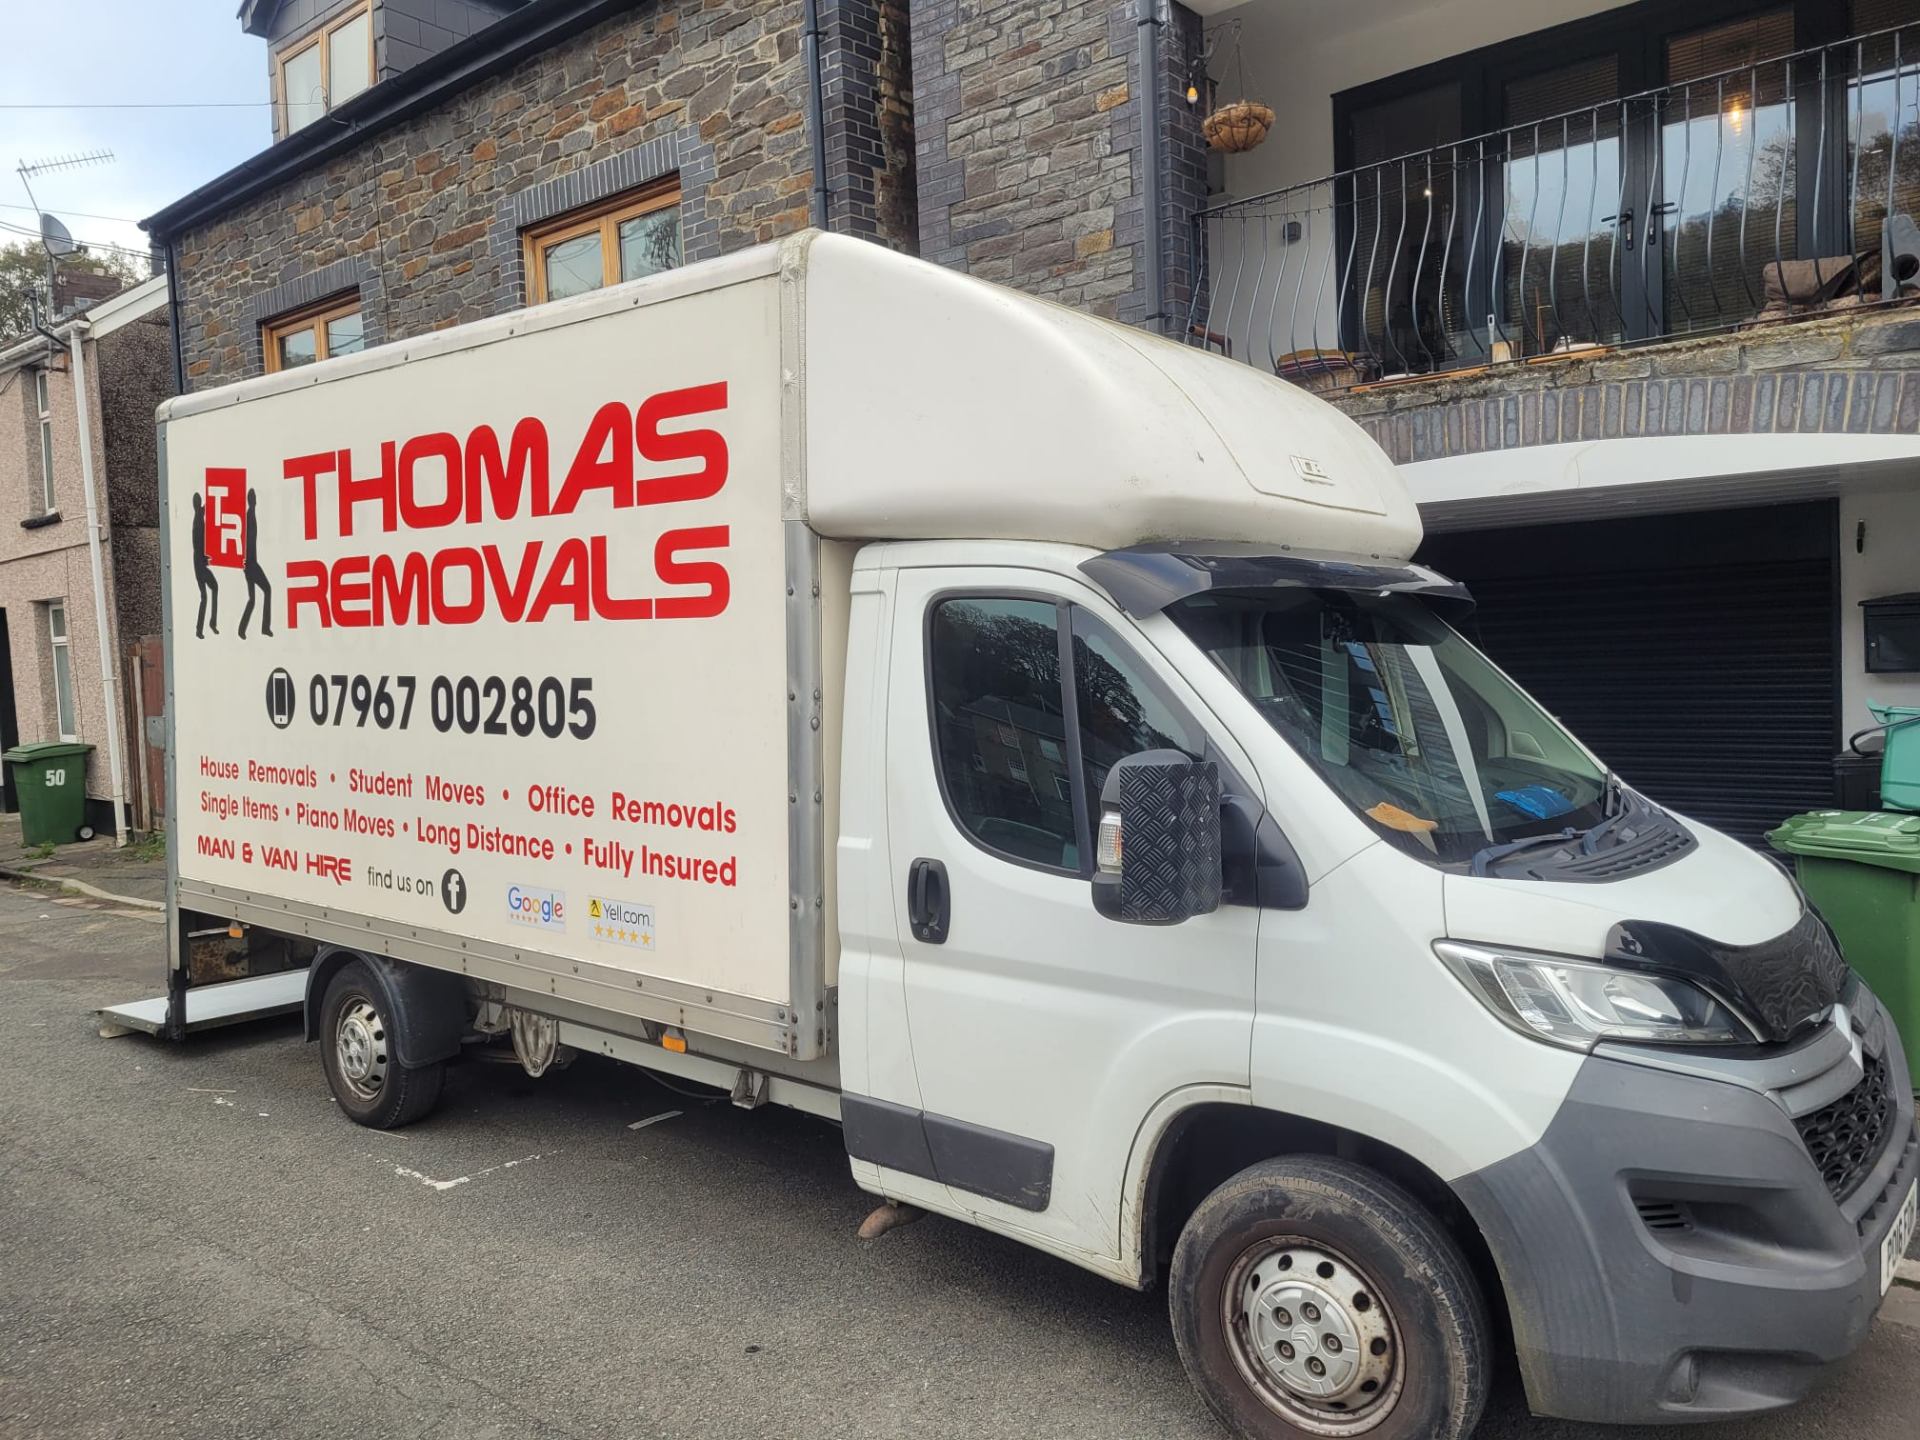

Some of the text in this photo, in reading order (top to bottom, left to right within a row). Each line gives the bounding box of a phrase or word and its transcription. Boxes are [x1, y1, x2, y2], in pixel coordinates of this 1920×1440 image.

[283, 381, 730, 541] THOMAS
[286, 525, 731, 629] REMOVALS
[309, 674, 596, 740] 07967 002805
[45, 769, 65, 787] 50
[200, 755, 737, 833] House Removals Student Moves Office Removals
[198, 835, 235, 860] MAN
[242, 843, 253, 863] &
[261, 845, 298, 872] VAN
[306, 853, 352, 886] HIRE
[367, 866, 393, 889] find
[397, 874, 412, 893] us
[416, 879, 434, 897] on
[200, 791, 737, 887] Single Items Piano Moves Long Distance Fully Insured
[508, 887, 563, 922] Google
[603, 902, 650, 926] Yell.com
